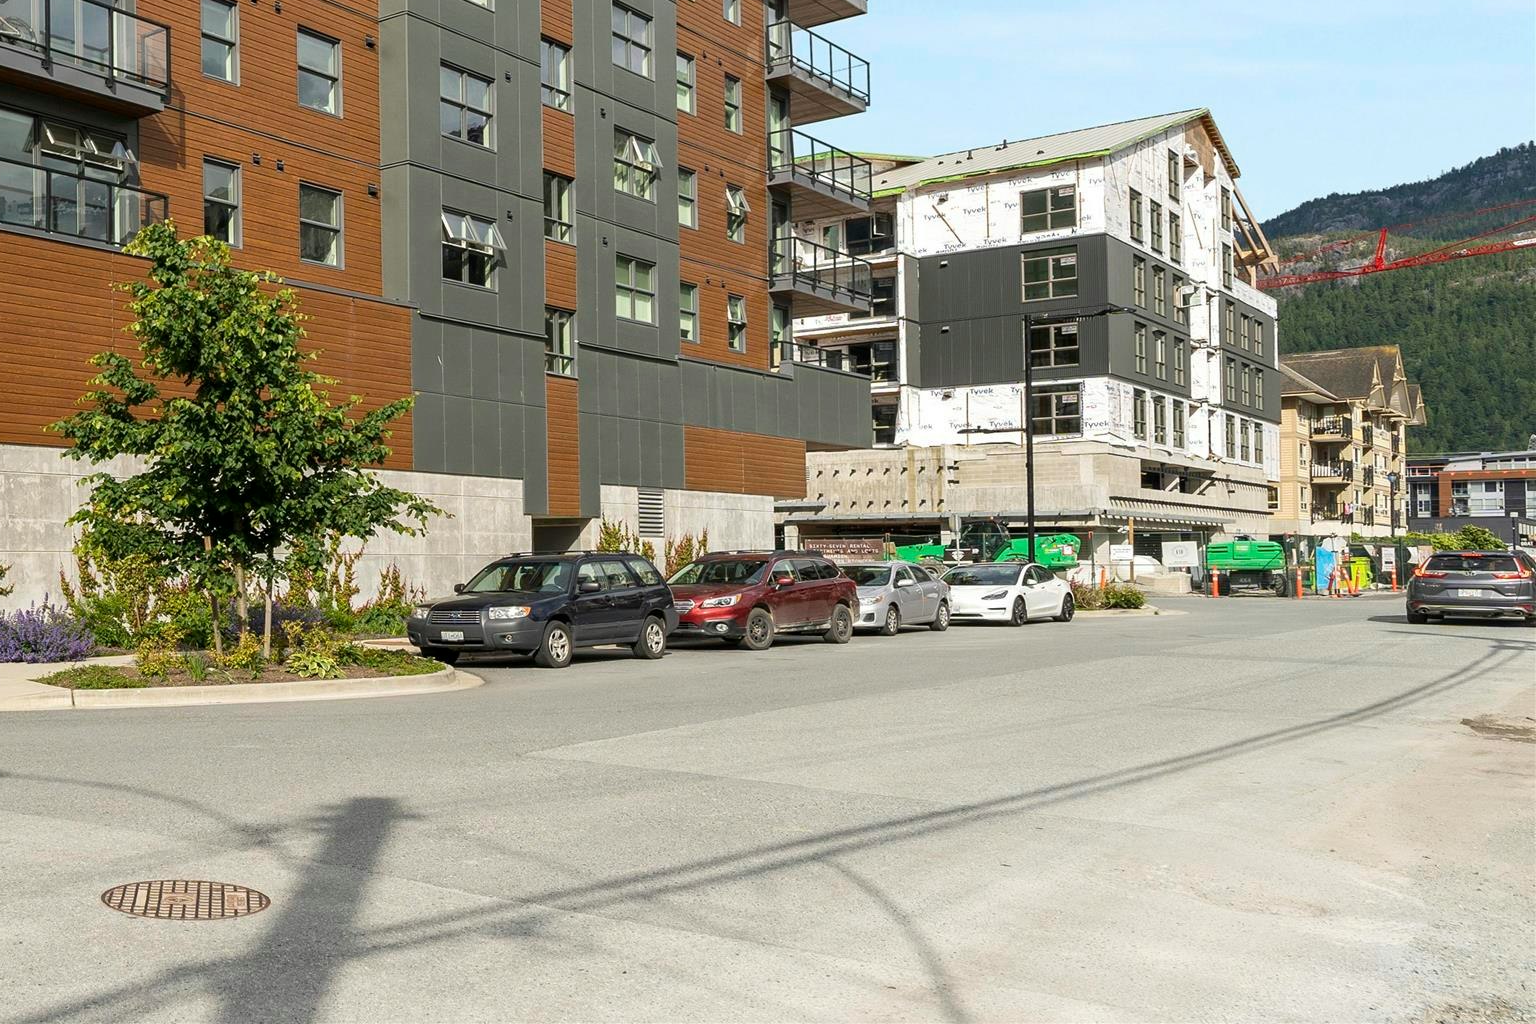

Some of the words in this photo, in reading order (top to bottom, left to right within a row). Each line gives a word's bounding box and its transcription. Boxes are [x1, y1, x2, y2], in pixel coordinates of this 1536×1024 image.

[963, 206, 986, 215] Tyvek
[983, 237, 1007, 245] Tyvek
[1084, 420, 1109, 429] Tyvek
